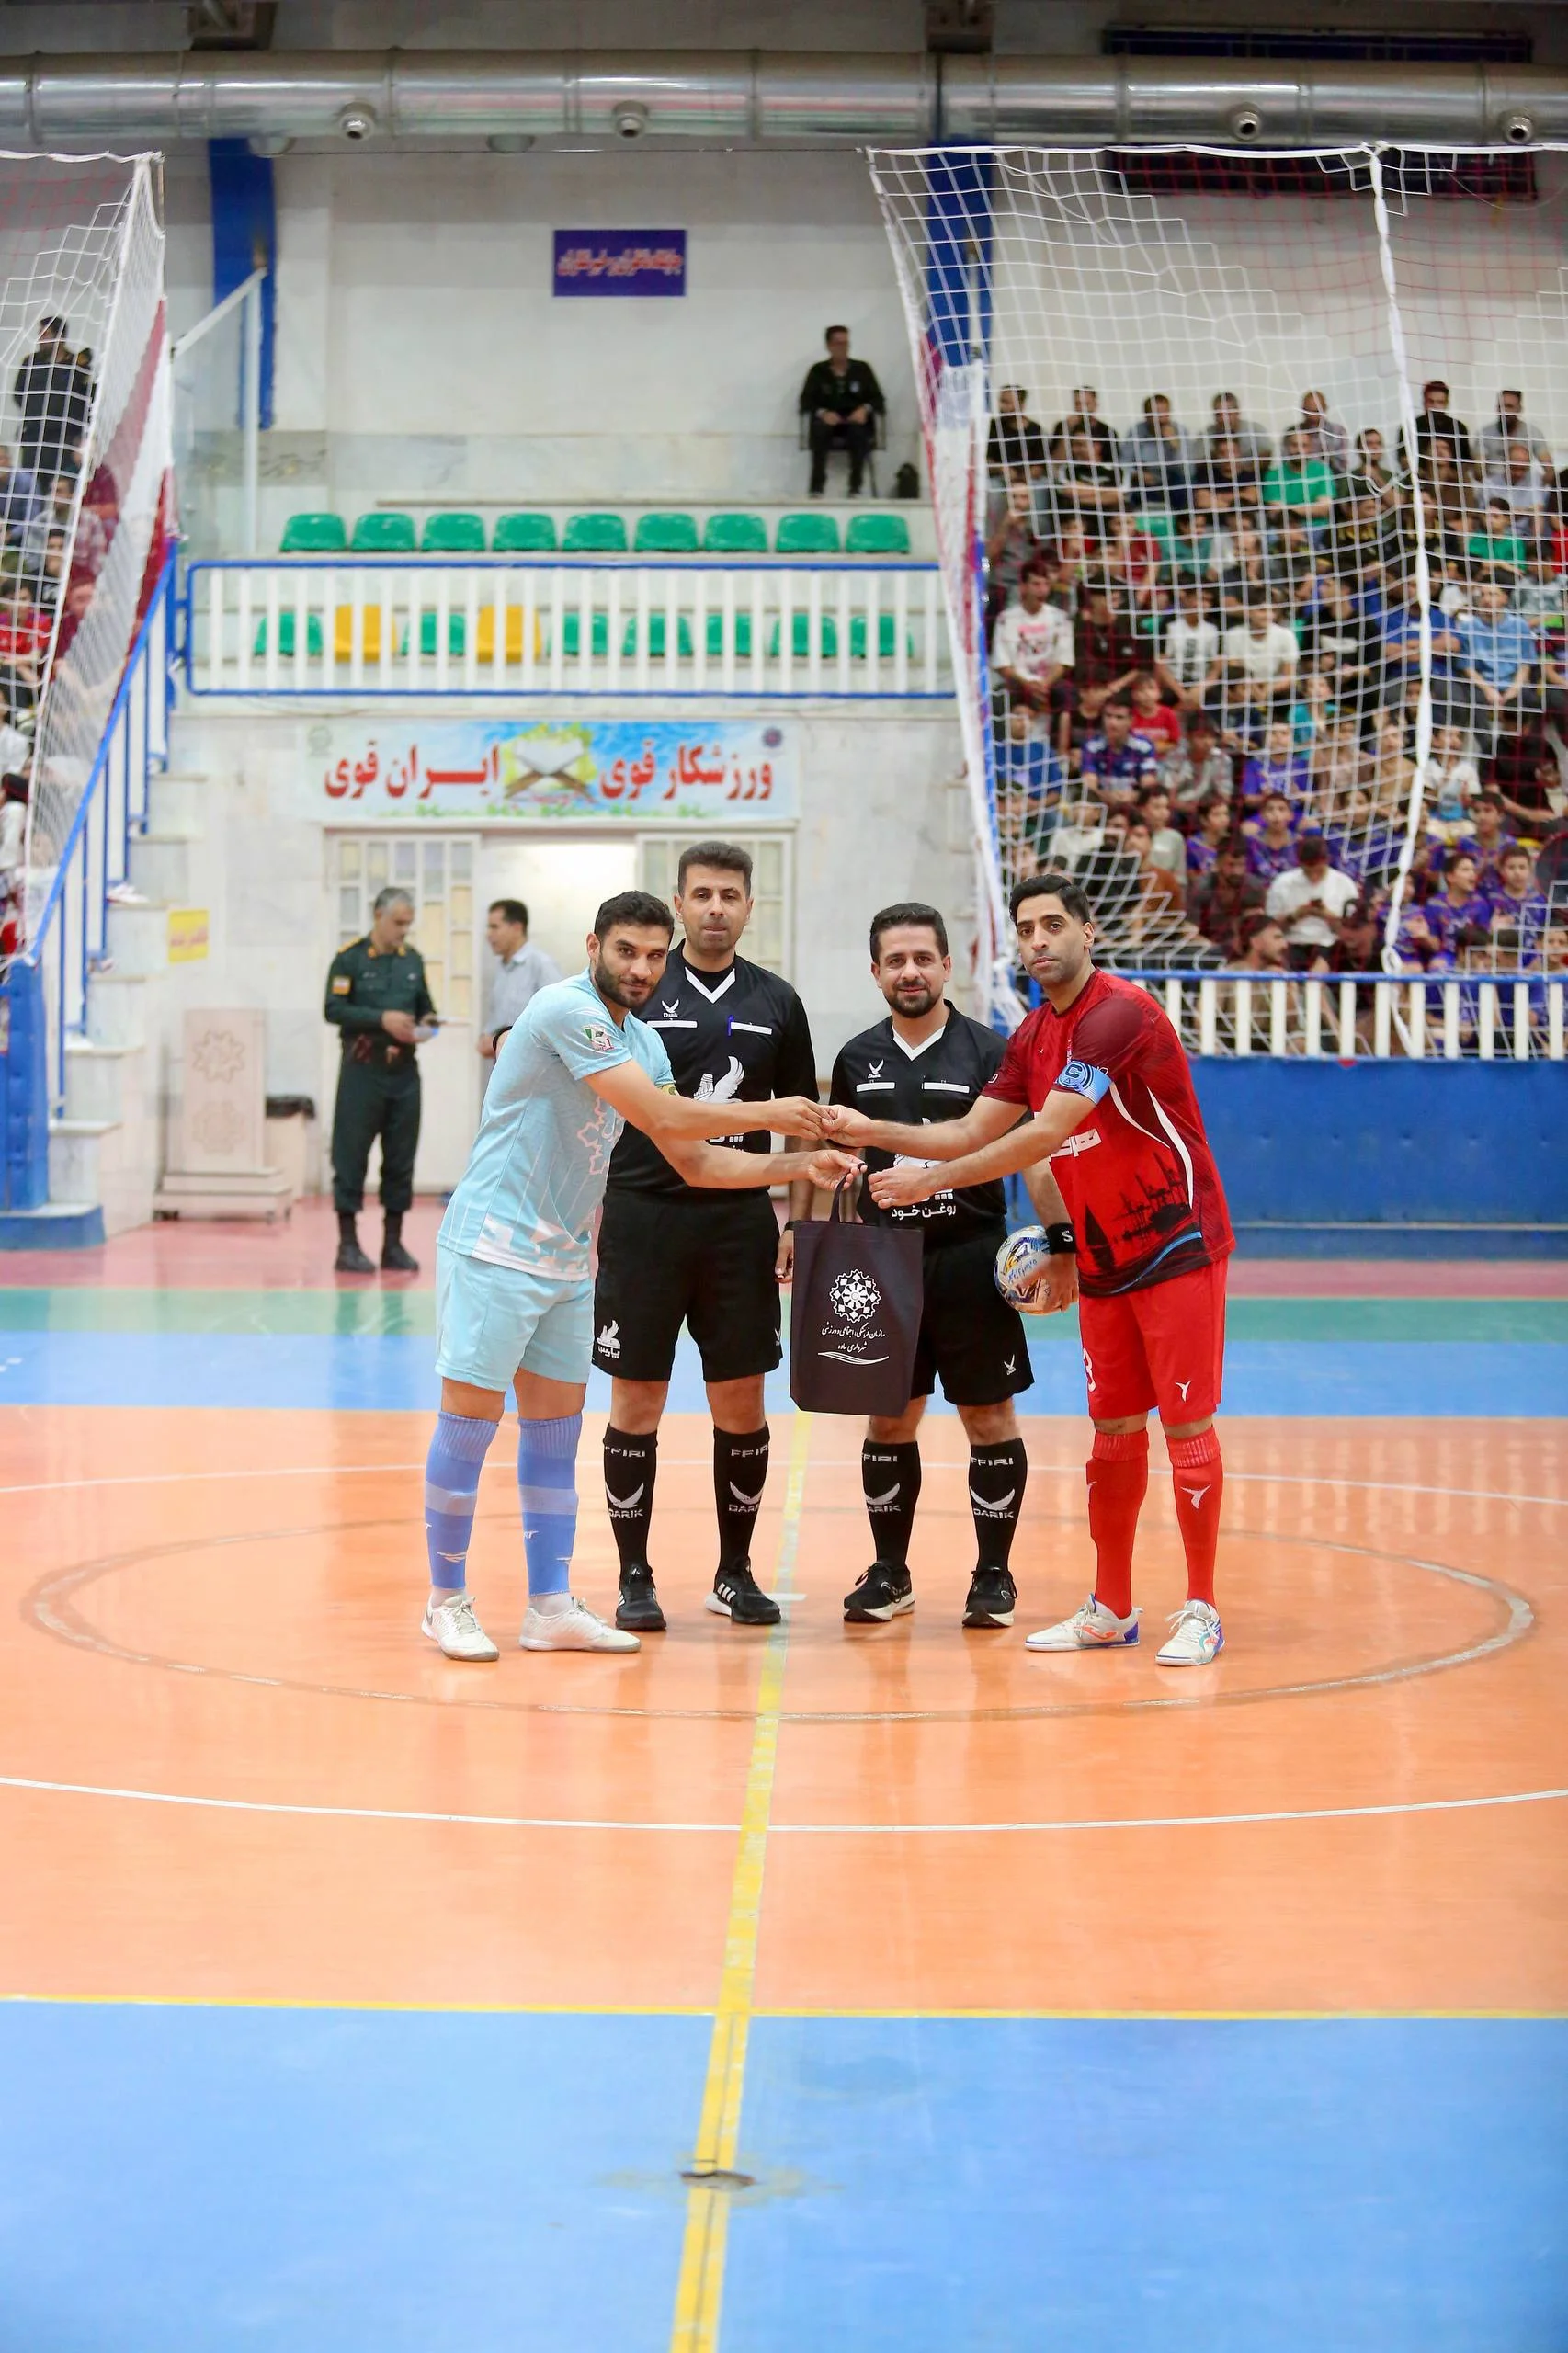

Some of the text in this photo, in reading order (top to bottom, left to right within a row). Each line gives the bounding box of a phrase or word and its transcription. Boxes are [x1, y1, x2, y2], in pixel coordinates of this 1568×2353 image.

[324, 739, 773, 801] ورزشکار قوی ایران قوی
[921, 1202, 957, 1218] روغن
[862, 1452, 898, 1462] FIRI
[971, 1456, 1014, 1467] FFIRI
[868, 1505, 902, 1514] ARIK
[973, 1508, 1015, 1519] DARIK
